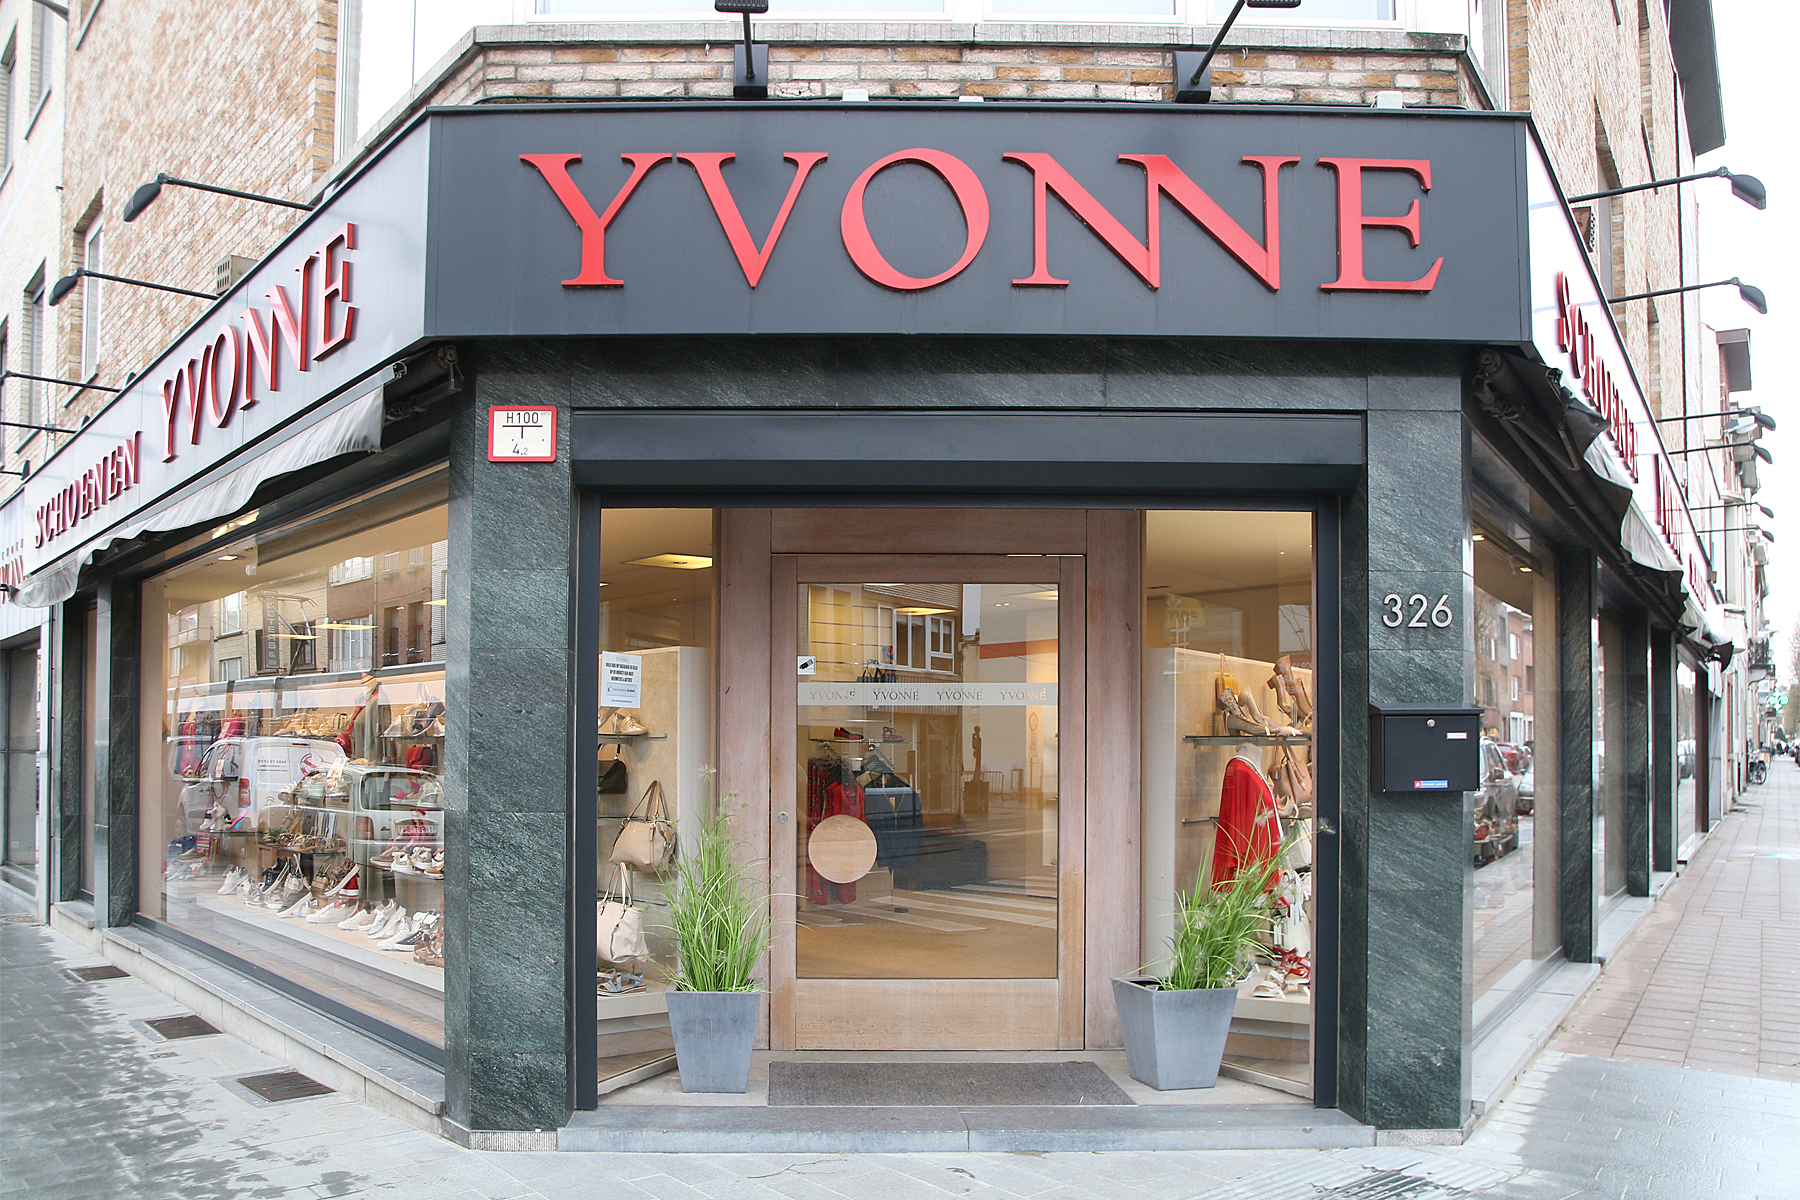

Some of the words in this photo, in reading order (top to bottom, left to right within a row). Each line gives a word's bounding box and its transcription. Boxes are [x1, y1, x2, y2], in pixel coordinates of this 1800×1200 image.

[519, 147, 1444, 292] YVONNE
[34, 431, 142, 549] SCHOENEN
[157, 222, 357, 463] YVONNE
[506, 411, 539, 424] H100
[1553, 270, 1639, 483] SCHOENEN
[1382, 593, 1454, 628] 326
[872, 690, 920, 701] YVONNE
[936, 690, 984, 701] YVONNE
[1000, 690, 1046, 701] YVONNE
